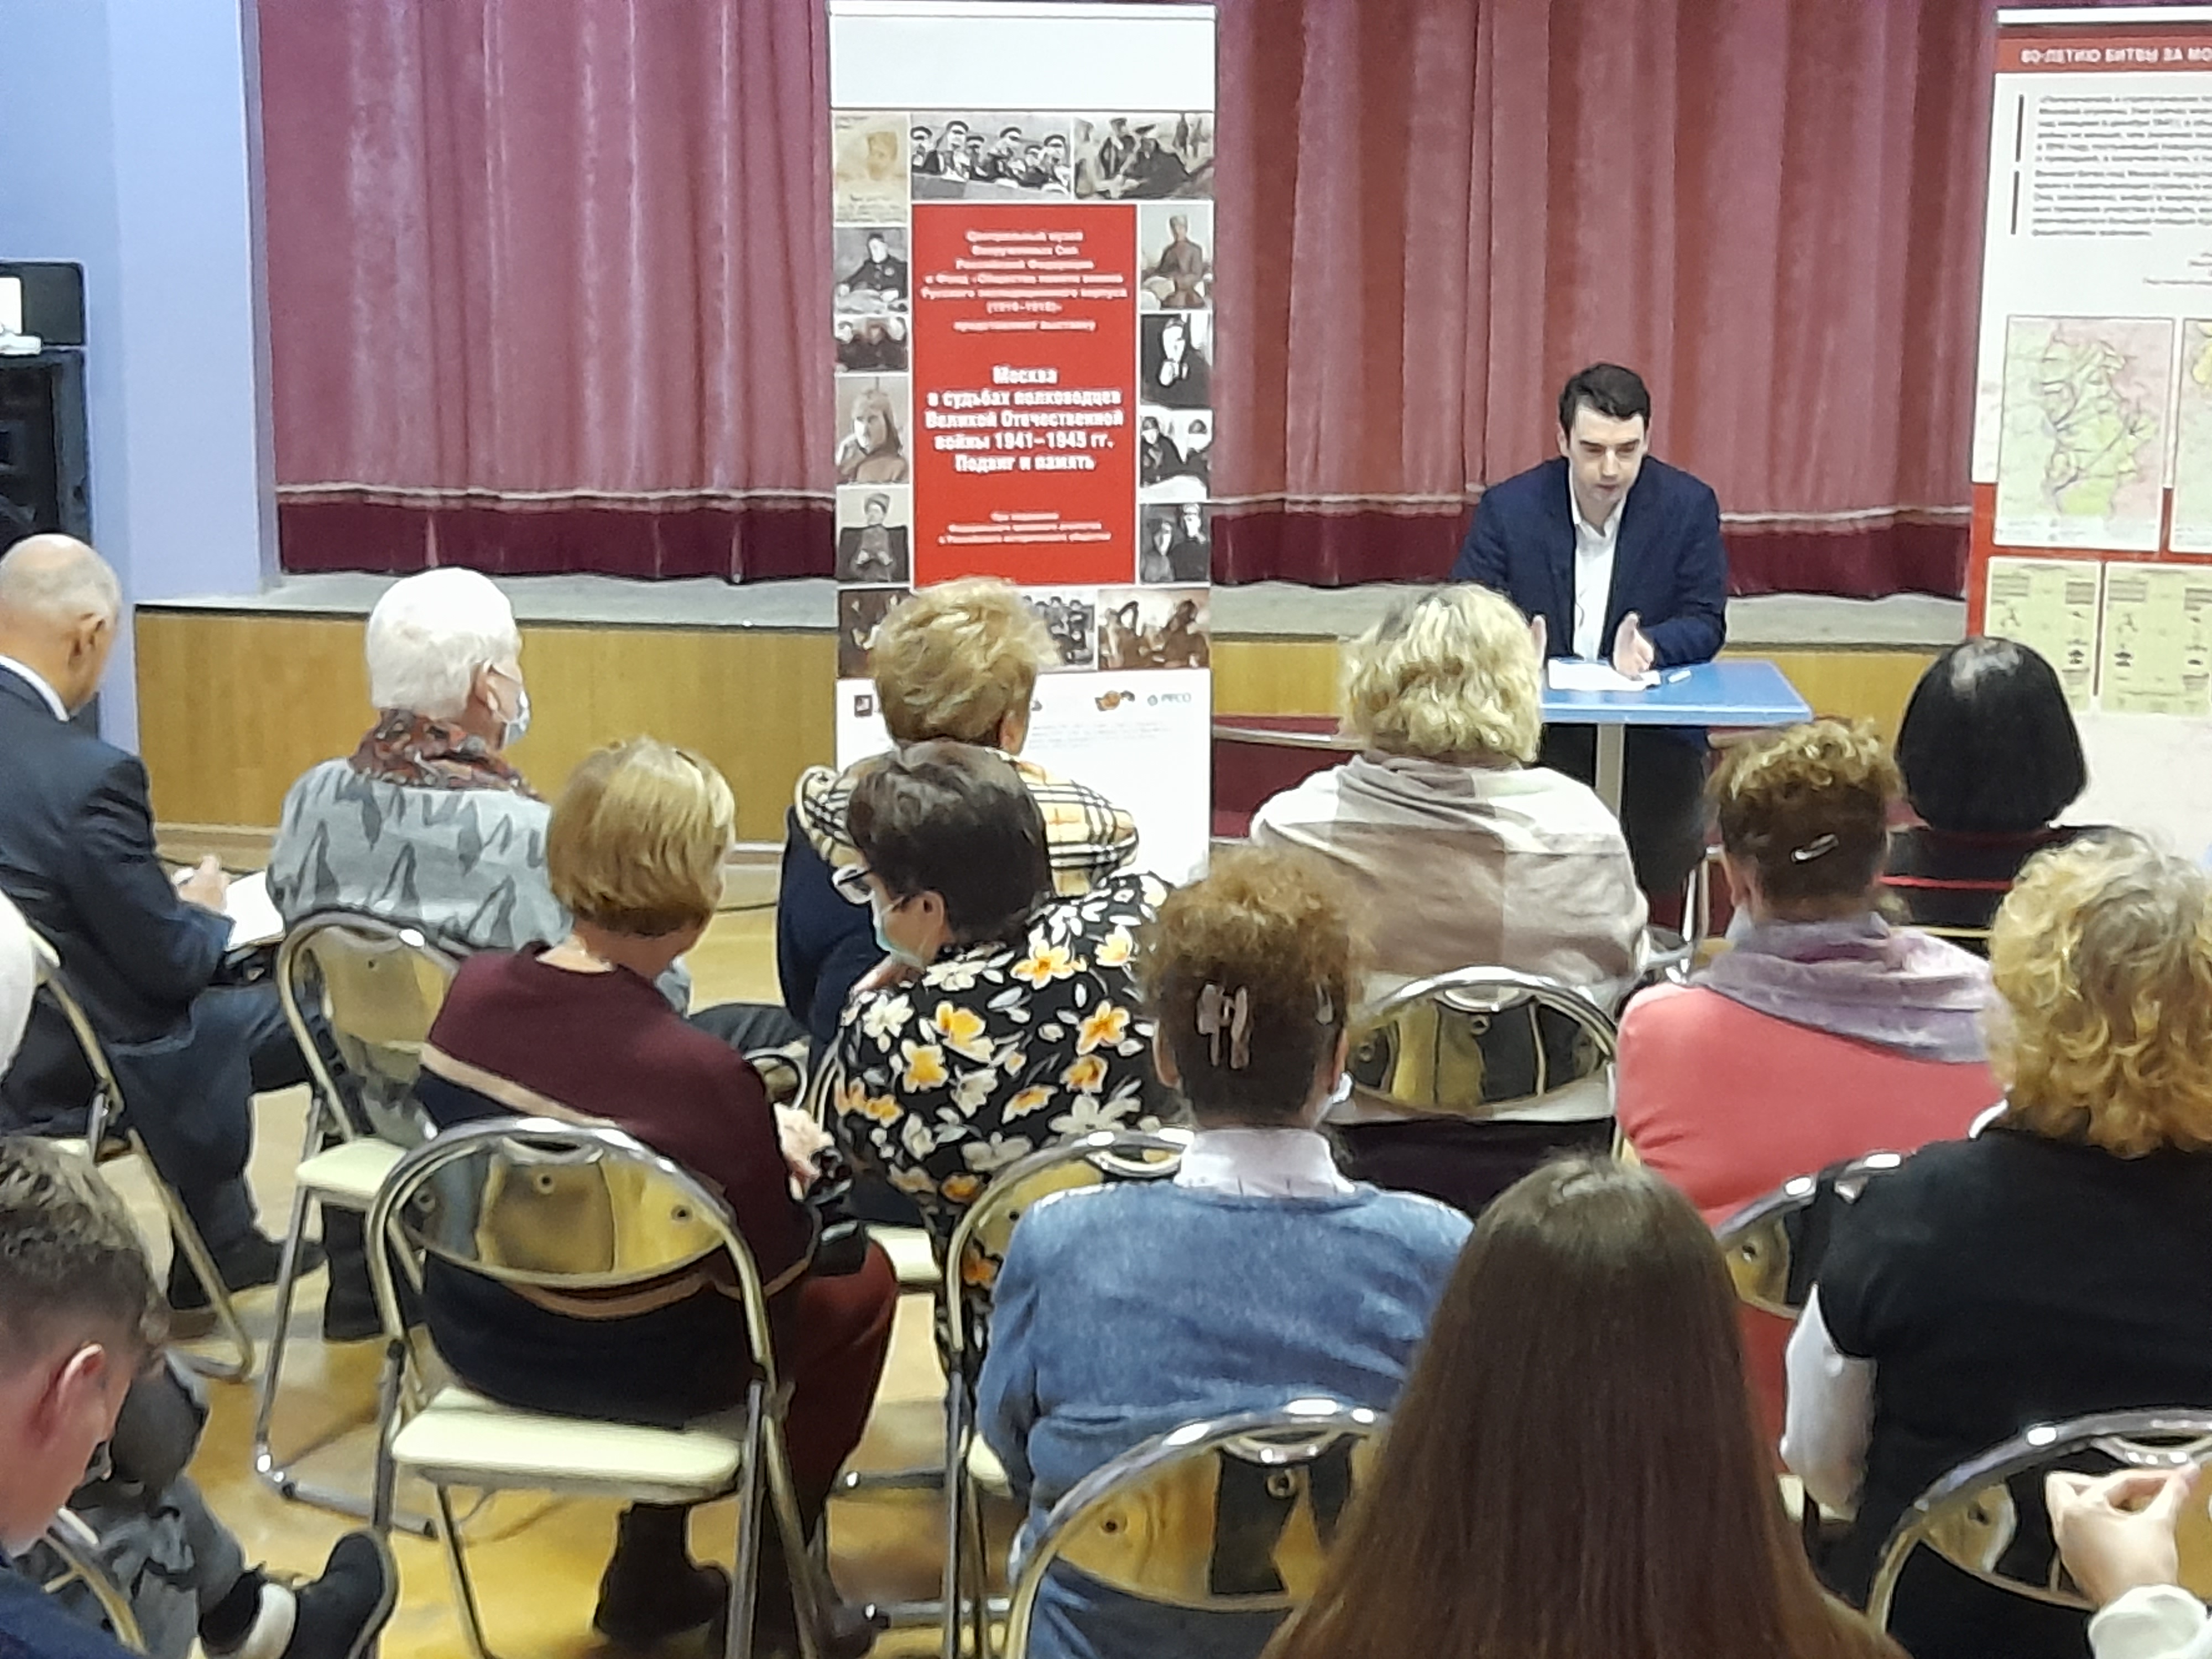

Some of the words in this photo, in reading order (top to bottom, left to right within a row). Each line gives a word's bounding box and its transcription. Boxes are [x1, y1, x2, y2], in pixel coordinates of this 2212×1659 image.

[2163, 47, 2184, 62] ЗА
[993, 365, 1058, 384] Москва
[942, 388, 1011, 409] судьбах
[1014, 390, 1122, 408] полководцев
[925, 410, 998, 429] Великой
[1000, 409, 1124, 428] Отечественной
[934, 434, 990, 450] войны
[1091, 434, 1115, 448] гг.
[955, 454, 1016, 473] Подвиг
[1019, 456, 1031, 471] и
[1034, 455, 1096, 471] память
